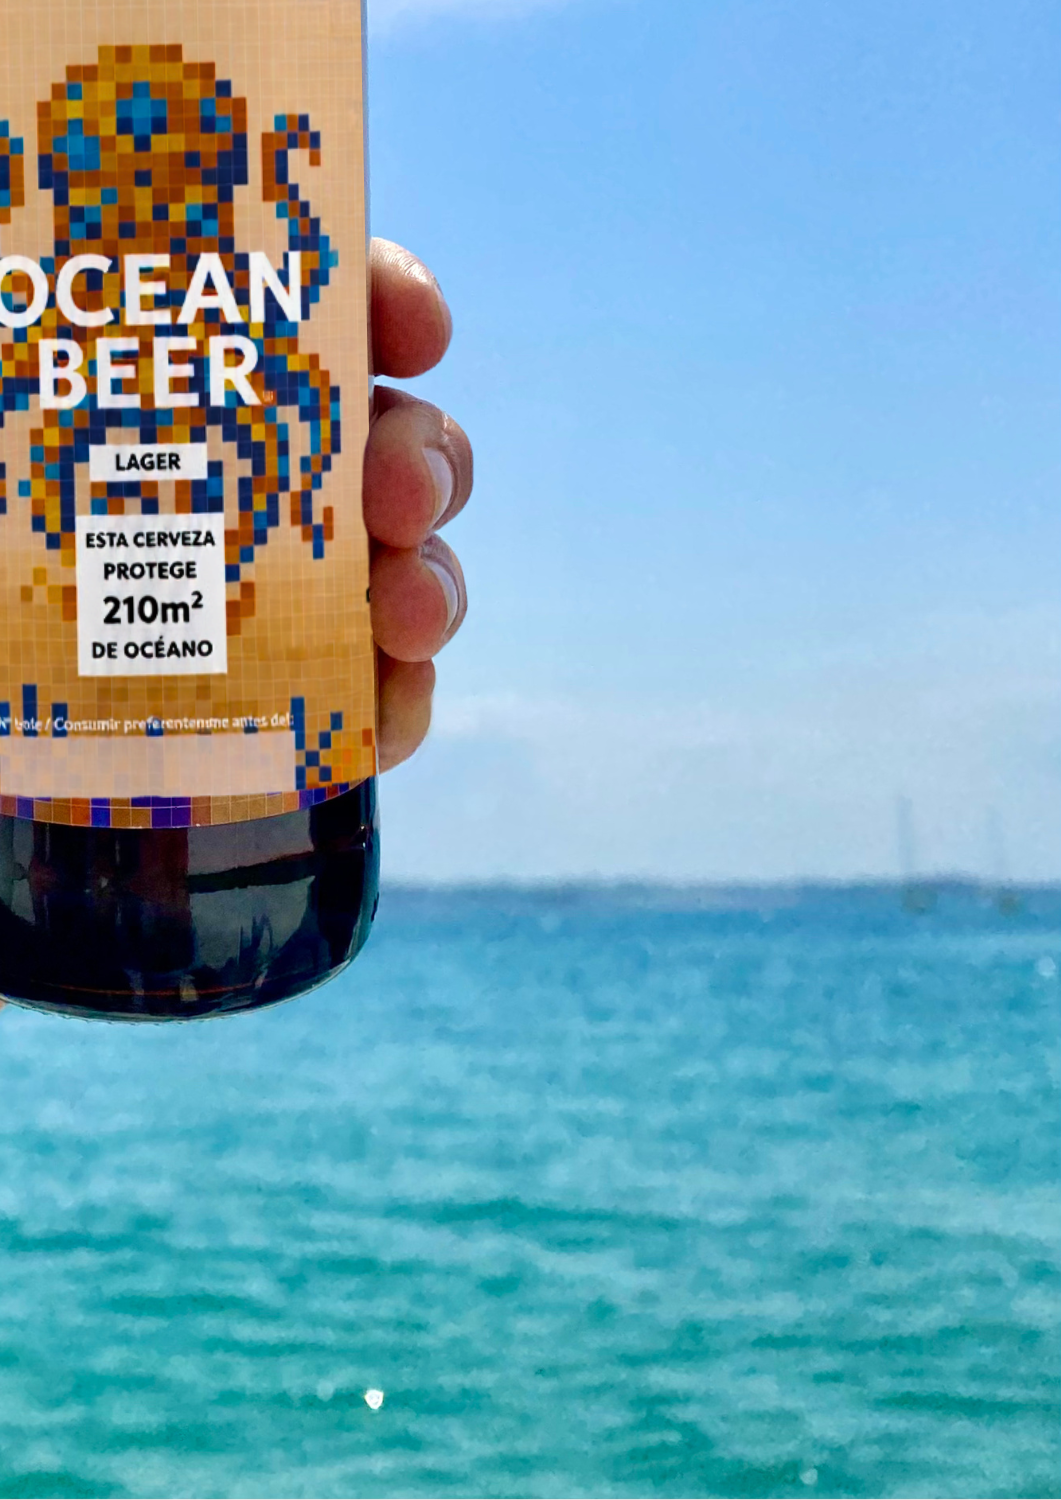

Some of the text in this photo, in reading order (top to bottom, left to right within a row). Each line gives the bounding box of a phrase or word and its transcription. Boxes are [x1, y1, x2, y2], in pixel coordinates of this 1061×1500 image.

[38, 335, 261, 409] BEER
[115, 453, 180, 471] LAGER
[86, 530, 215, 549] ESTA CERVEZA
[103, 561, 198, 581] PROTEGE
[92, 635, 213, 659] DE OCÉANO
[54, 716, 121, 732] Consumir
[232, 714, 269, 728] antes
